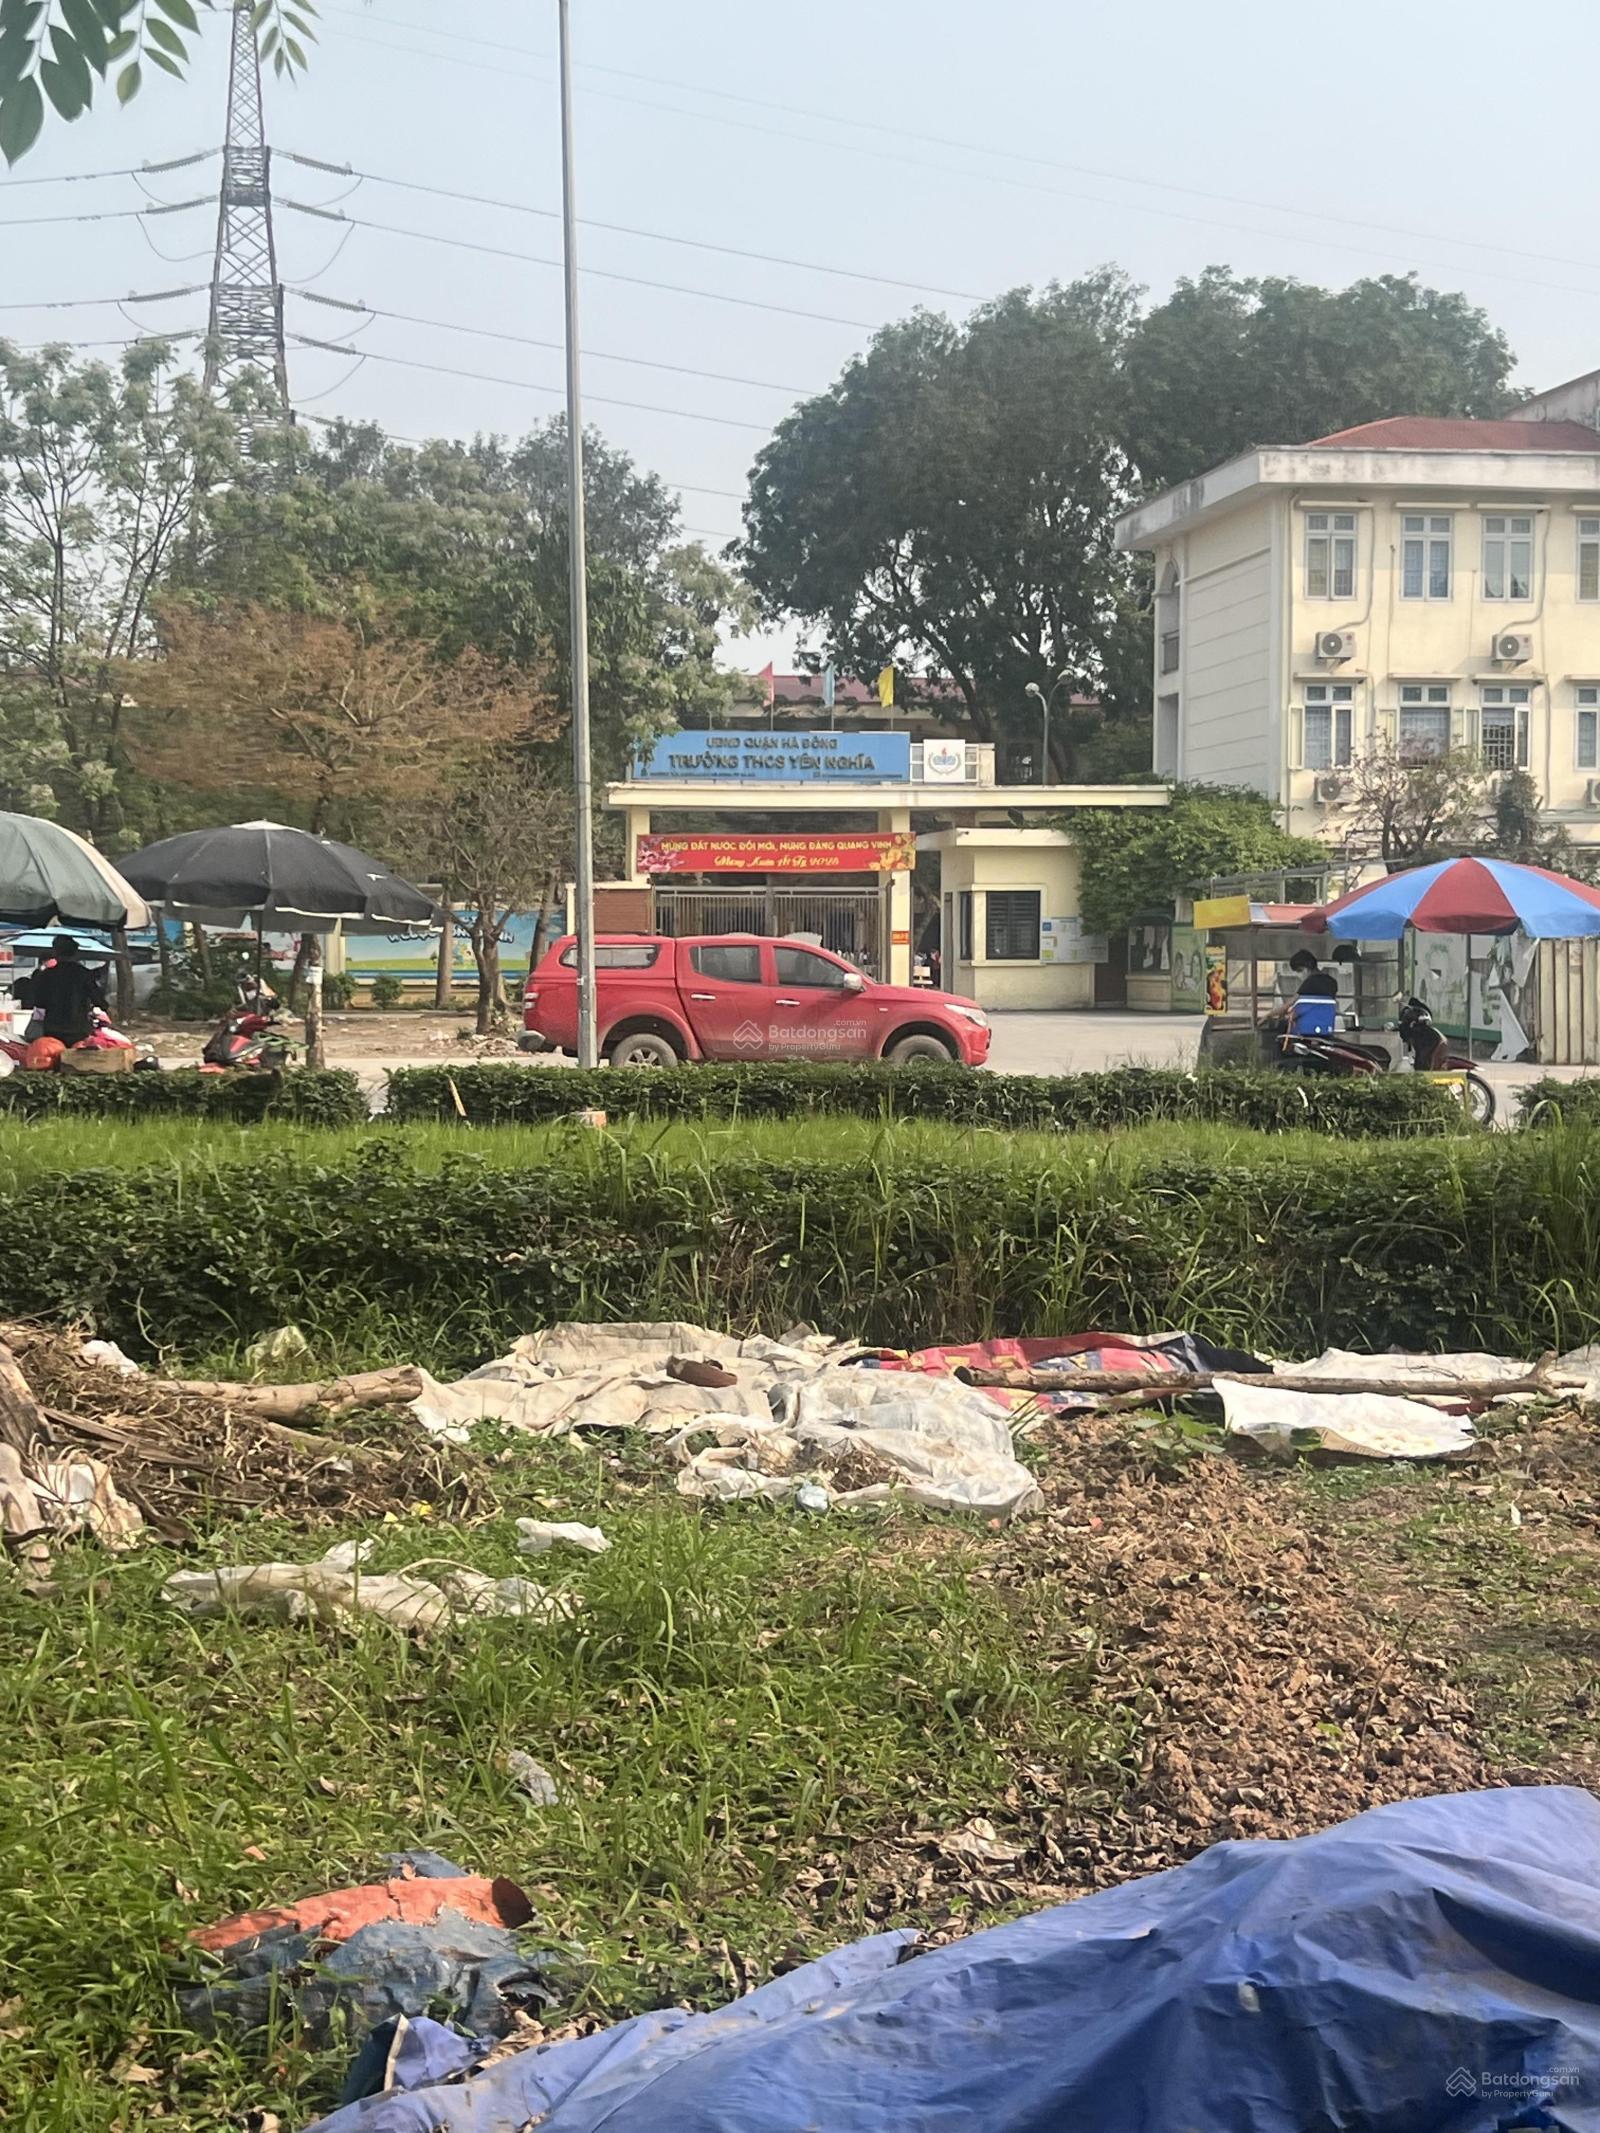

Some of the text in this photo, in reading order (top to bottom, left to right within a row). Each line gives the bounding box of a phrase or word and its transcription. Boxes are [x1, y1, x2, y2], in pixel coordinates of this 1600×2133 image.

[743, 736, 779, 750] QUẬN
[781, 736, 800, 749] HÀ
[801, 736, 838, 749] ĐÔNG
[669, 750, 875, 769] TRƯỜNG THCS YÊN NGHĨA
[661, 840, 689, 850] MỪNG
[690, 839, 709, 851] ĐẤT
[710, 840, 738, 851] NƯỚC
[780, 840, 807, 851] MỪNG
[808, 840, 835, 851] ĐẢNG
[836, 840, 869, 851] QUANG
[870, 840, 893, 850] VINH
